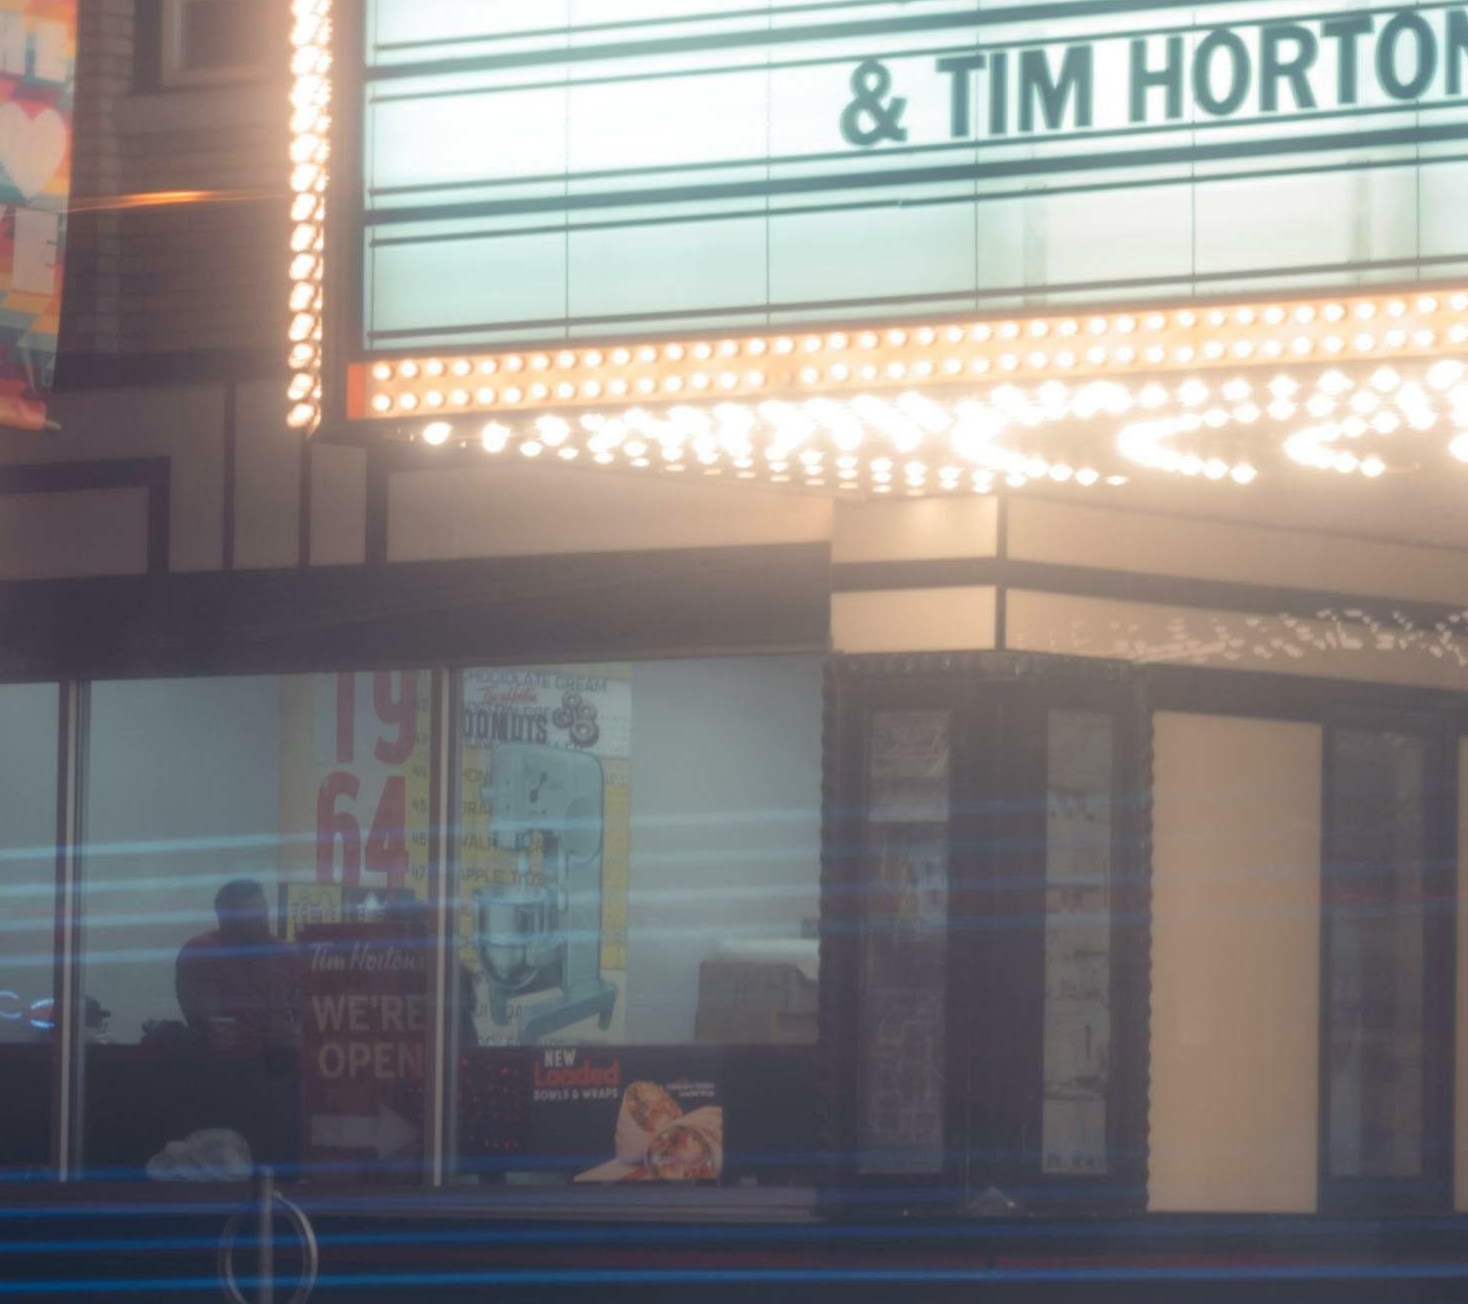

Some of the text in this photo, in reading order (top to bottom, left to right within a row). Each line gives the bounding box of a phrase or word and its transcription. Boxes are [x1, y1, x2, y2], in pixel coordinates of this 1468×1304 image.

[839, 58, 908, 148] &
[936, 42, 1095, 139] TIM
[311, 993, 427, 1032] WE'RE
[317, 1041, 426, 1080] OPEN
[533, 1056, 620, 1088] Loaded
[544, 1048, 577, 1068] NEW
[533, 1088, 570, 1102] BOWLS
[583, 1087, 618, 1100] WRAPS
